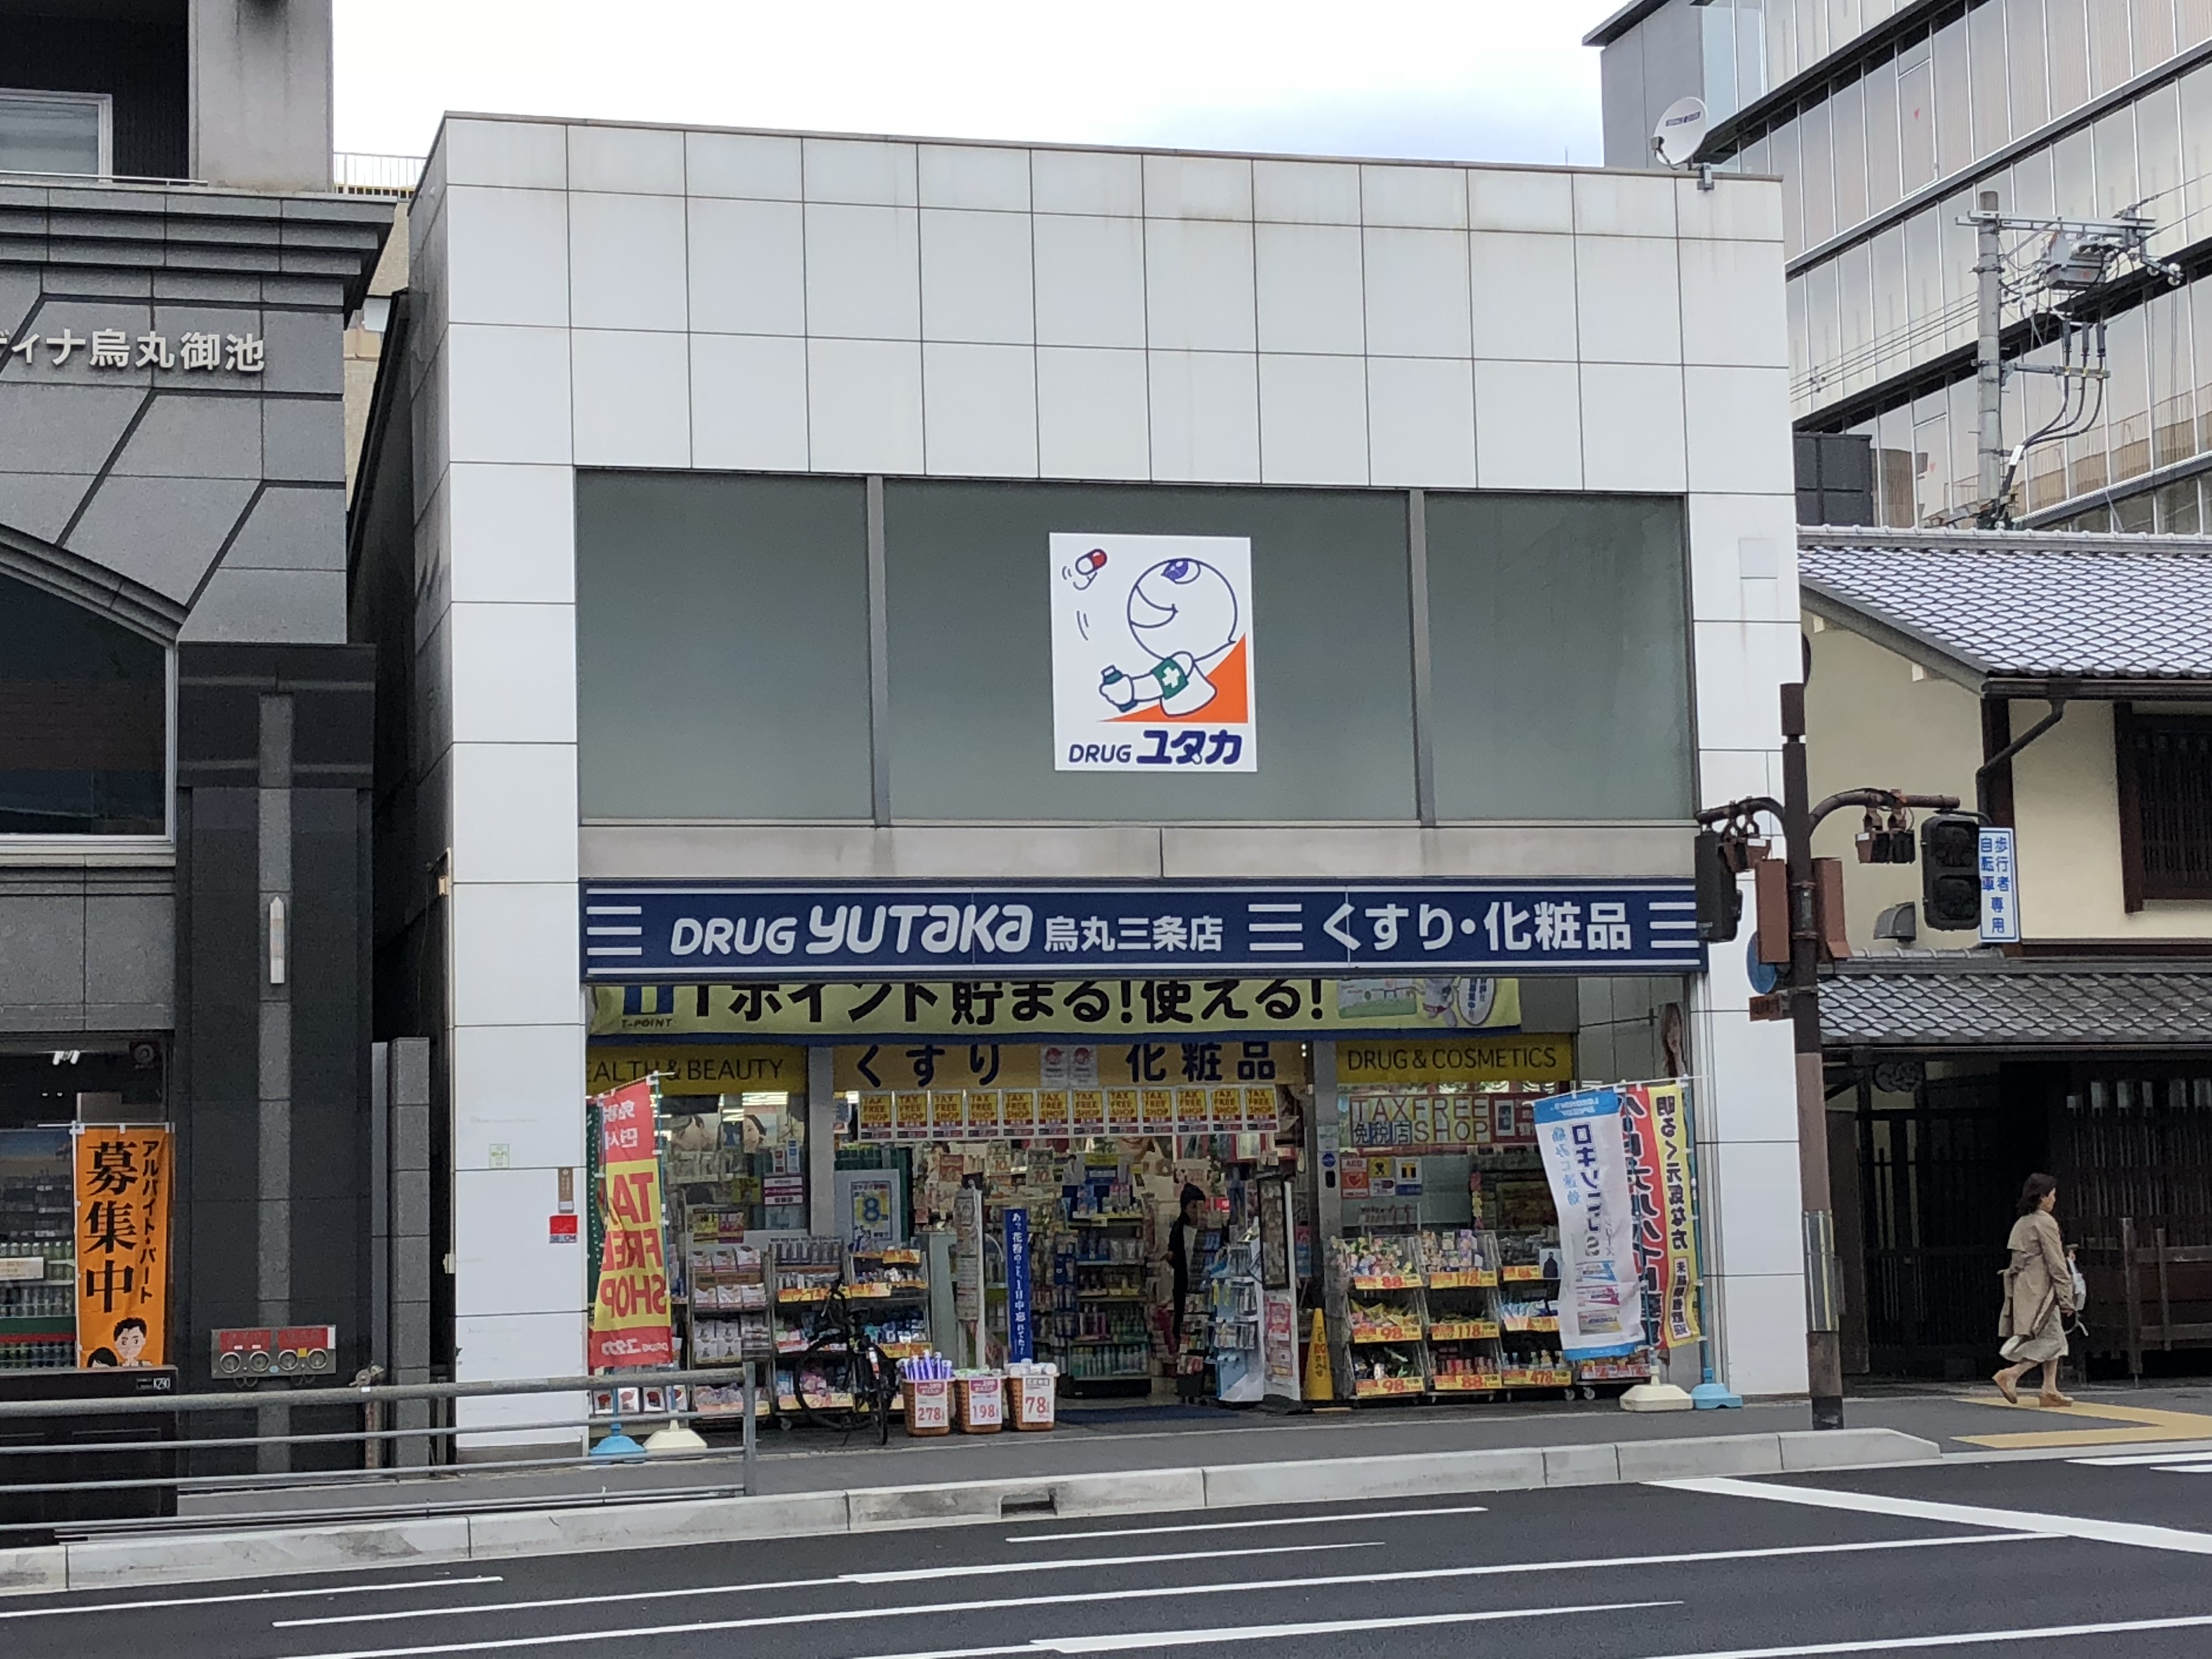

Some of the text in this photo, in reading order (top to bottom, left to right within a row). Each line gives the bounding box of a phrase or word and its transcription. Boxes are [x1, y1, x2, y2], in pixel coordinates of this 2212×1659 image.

[0, 328, 264, 371] ィナ烏丸御池
[1069, 729, 1243, 765] DRUG ユタカ
[1980, 837, 1995, 891] 自転車
[1995, 837, 2010, 891] 歩行者
[670, 917, 798, 956] DRUG
[1044, 916, 1223, 952] 烏丸三条店
[1323, 902, 1632, 951] くすり・化粧品
[621, 1019, 673, 1029] T-POINT
[687, 1059, 783, 1081] BEAUTY
[857, 1044, 1000, 1087] くすり
[1126, 1042, 1276, 1084] 化粧品
[1347, 1047, 1556, 1071] DRUG & COSMETICS
[1414, 1120, 1488, 1142] SHOP
[83, 1141, 138, 1313] 募集中
[139, 1140, 159, 1304] アルバイト・パート
[917, 1407, 941, 1421] 278
[972, 1404, 995, 1418] 198
[1025, 1396, 1047, 1414] 78
